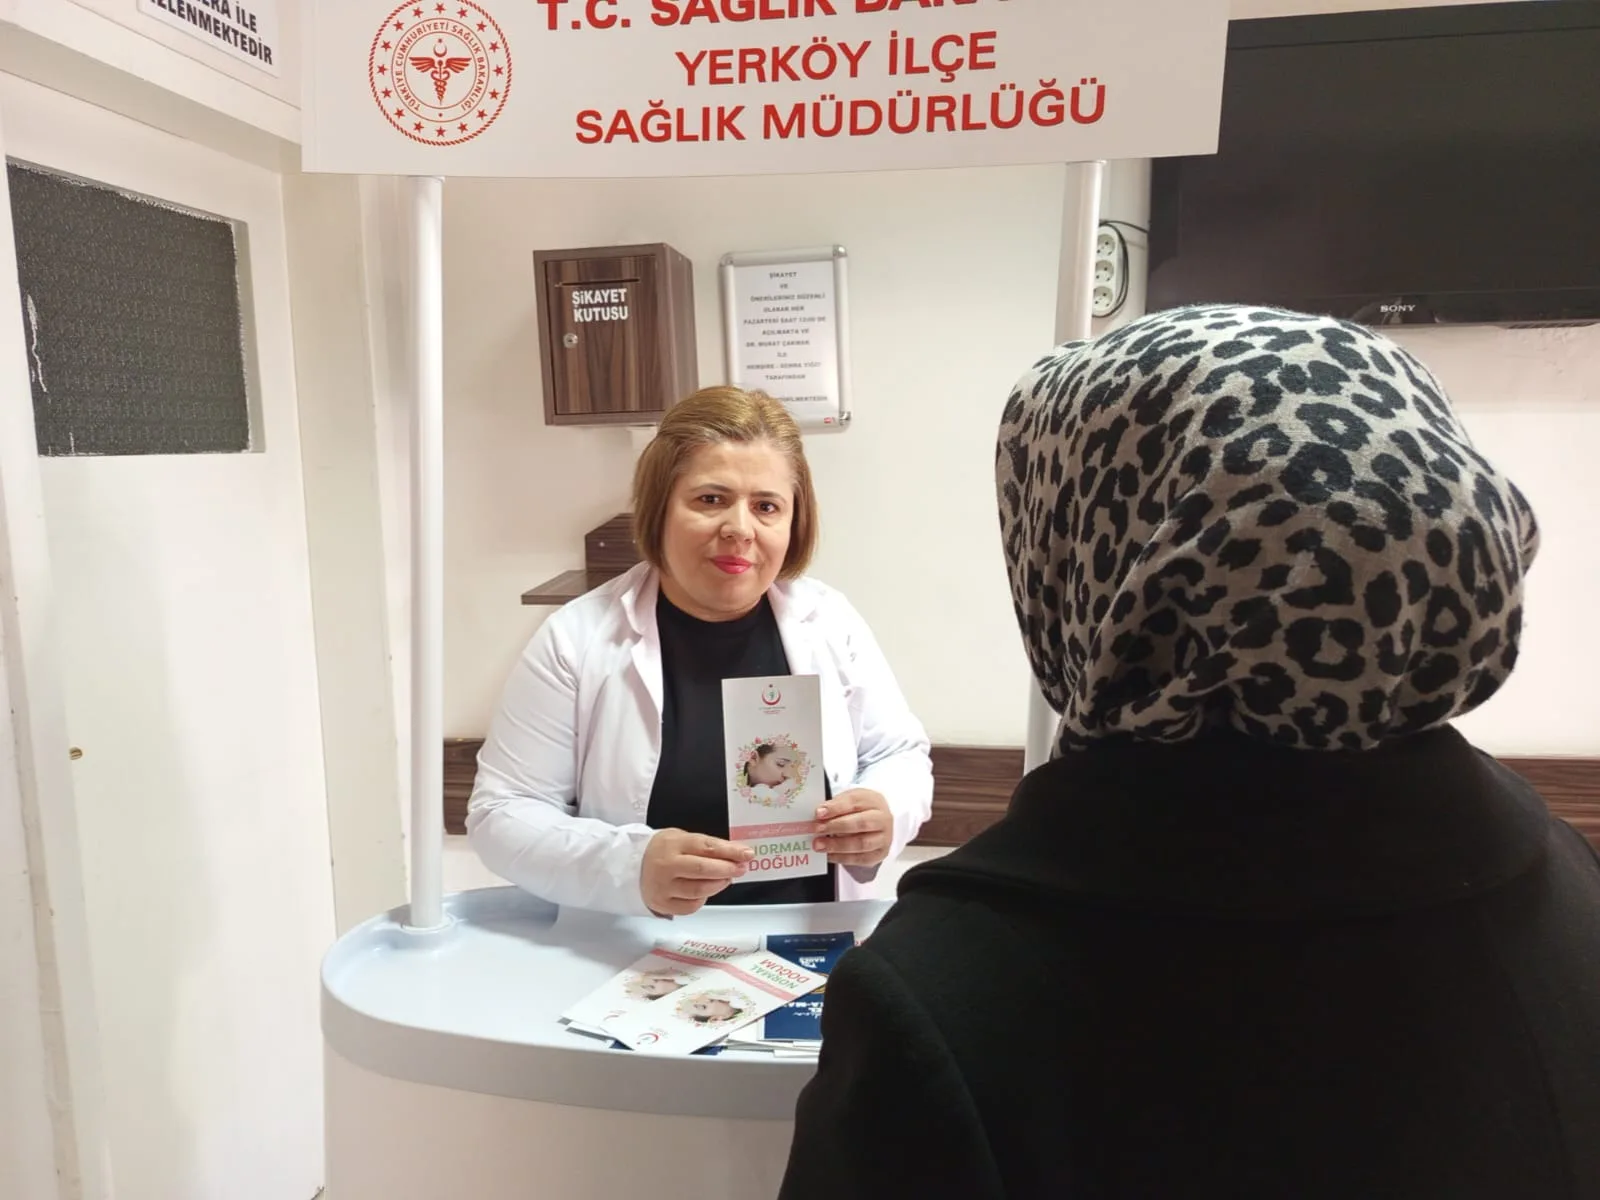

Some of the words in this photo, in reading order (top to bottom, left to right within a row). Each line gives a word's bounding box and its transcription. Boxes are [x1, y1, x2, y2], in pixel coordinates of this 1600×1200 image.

[235, 1, 257, 33] İLE
[537, 0, 631, 30] T.C.
[395, 21, 449, 67] CUMHURİYETİ
[451, 25, 482, 55] SAĞLIK
[676, 36, 872, 86] YERKÖY
[888, 30, 997, 83] İLÇE
[461, 57, 486, 111] BAKANLIĞI
[575, 99, 746, 144] SAĞLIK
[763, 77, 1106, 140] MÜDÜRLÜĞÜ
[573, 305, 628, 323] KUTUSU
[1380, 304, 1416, 313] SONY
[748, 853, 809, 872] DOĞUM
[749, 964, 800, 989] NORMAL
